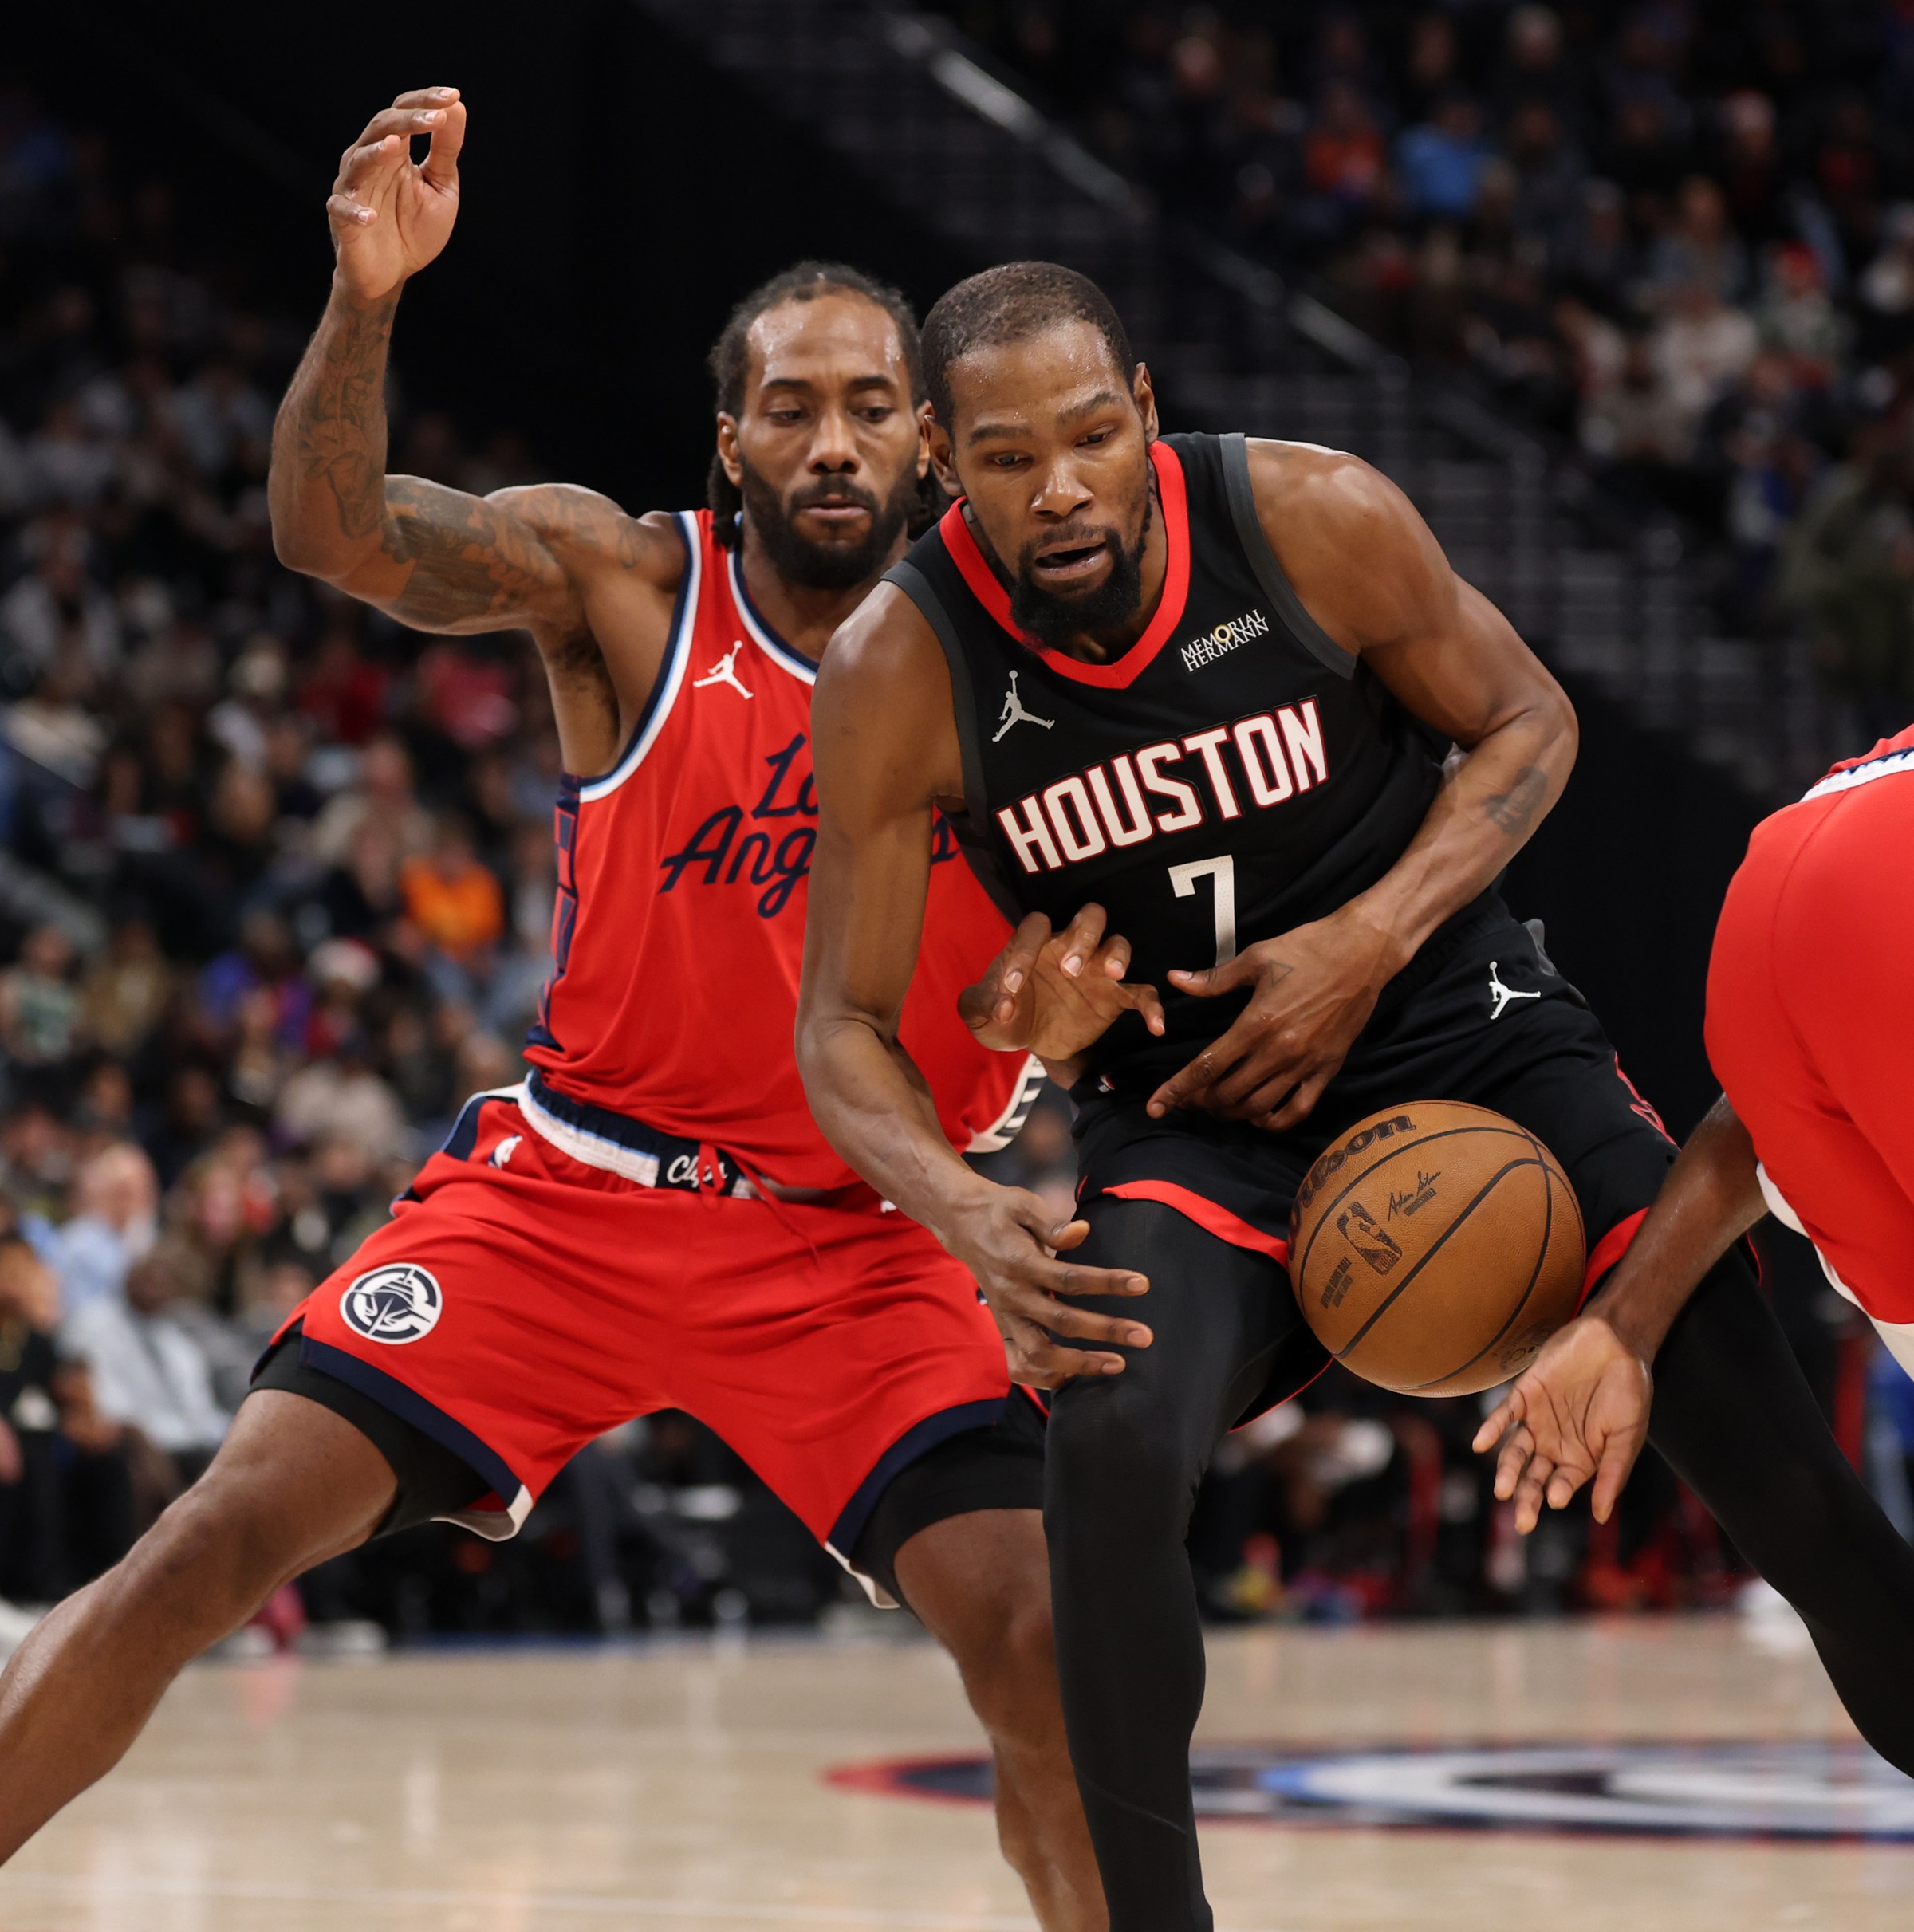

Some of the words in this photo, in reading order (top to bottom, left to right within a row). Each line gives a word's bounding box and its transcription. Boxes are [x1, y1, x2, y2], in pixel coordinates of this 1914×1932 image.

[1180, 608, 1266, 661] MEMORIAL
[1183, 619, 1270, 672] HERMANN
[994, 697, 1329, 875] HOUSTON
[1168, 854, 1236, 968] 7
